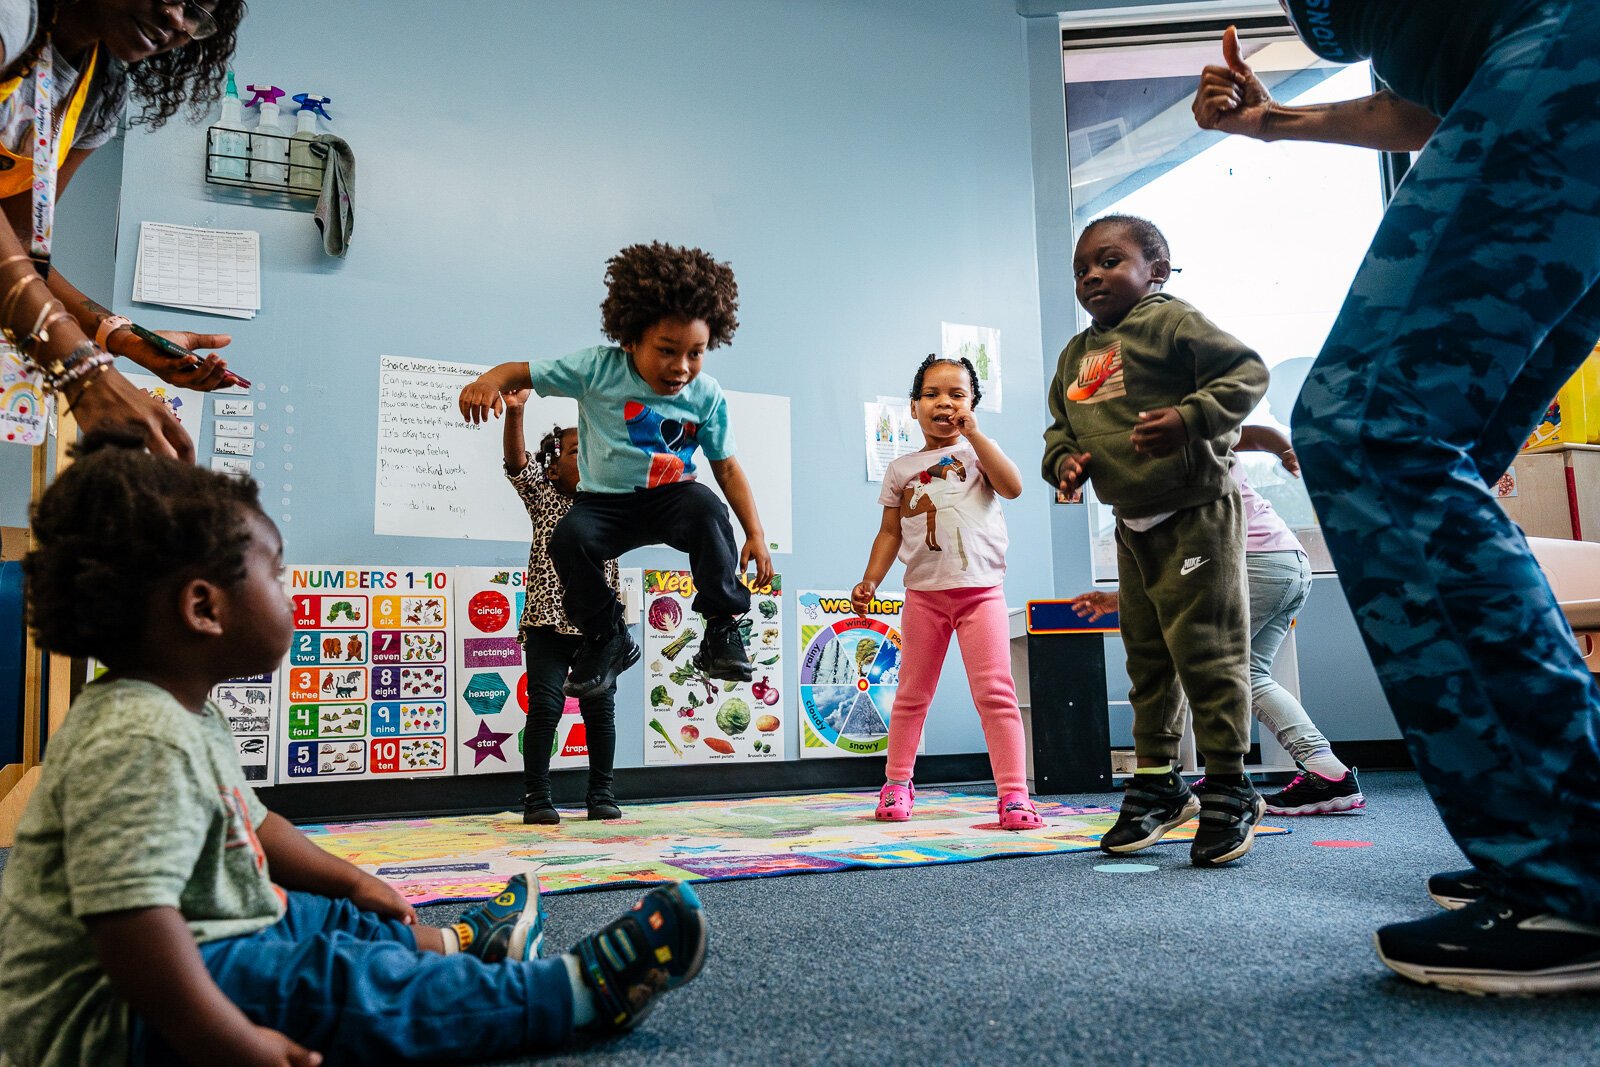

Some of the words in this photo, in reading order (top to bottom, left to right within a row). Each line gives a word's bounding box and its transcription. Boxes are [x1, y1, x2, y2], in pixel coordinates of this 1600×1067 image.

[382, 358, 409, 370] Choice
[382, 374, 400, 385] Can
[401, 380, 412, 388] you
[381, 388, 390, 398] It
[392, 390, 408, 398] looks
[427, 432, 440, 440] cry
[1184, 556, 1202, 568] NIKE
[292, 570, 398, 589] NUMBERS
[301, 599, 310, 616] 1
[380, 599, 393, 616] 6
[477, 606, 502, 616] circle
[845, 619, 872, 629] windy
[299, 635, 312, 652] 2
[381, 634, 393, 651] 7
[472, 648, 514, 658] rectangle
[806, 643, 820, 669] rainy
[300, 672, 312, 689] 3
[380, 669, 392, 686] 8
[292, 691, 318, 699] three
[375, 687, 397, 698] eight
[468, 688, 506, 699] hexagon
[297, 710, 310, 726] 4
[378, 706, 390, 723] 9
[806, 700, 826, 731] cloudy
[230, 720, 256, 731] gray
[293, 727, 314, 736] four
[477, 739, 498, 748] star
[848, 741, 879, 752] snowy
[298, 746, 310, 763] 5
[374, 743, 396, 760] 10
[294, 764, 312, 774] five
[378, 762, 394, 770] ten
